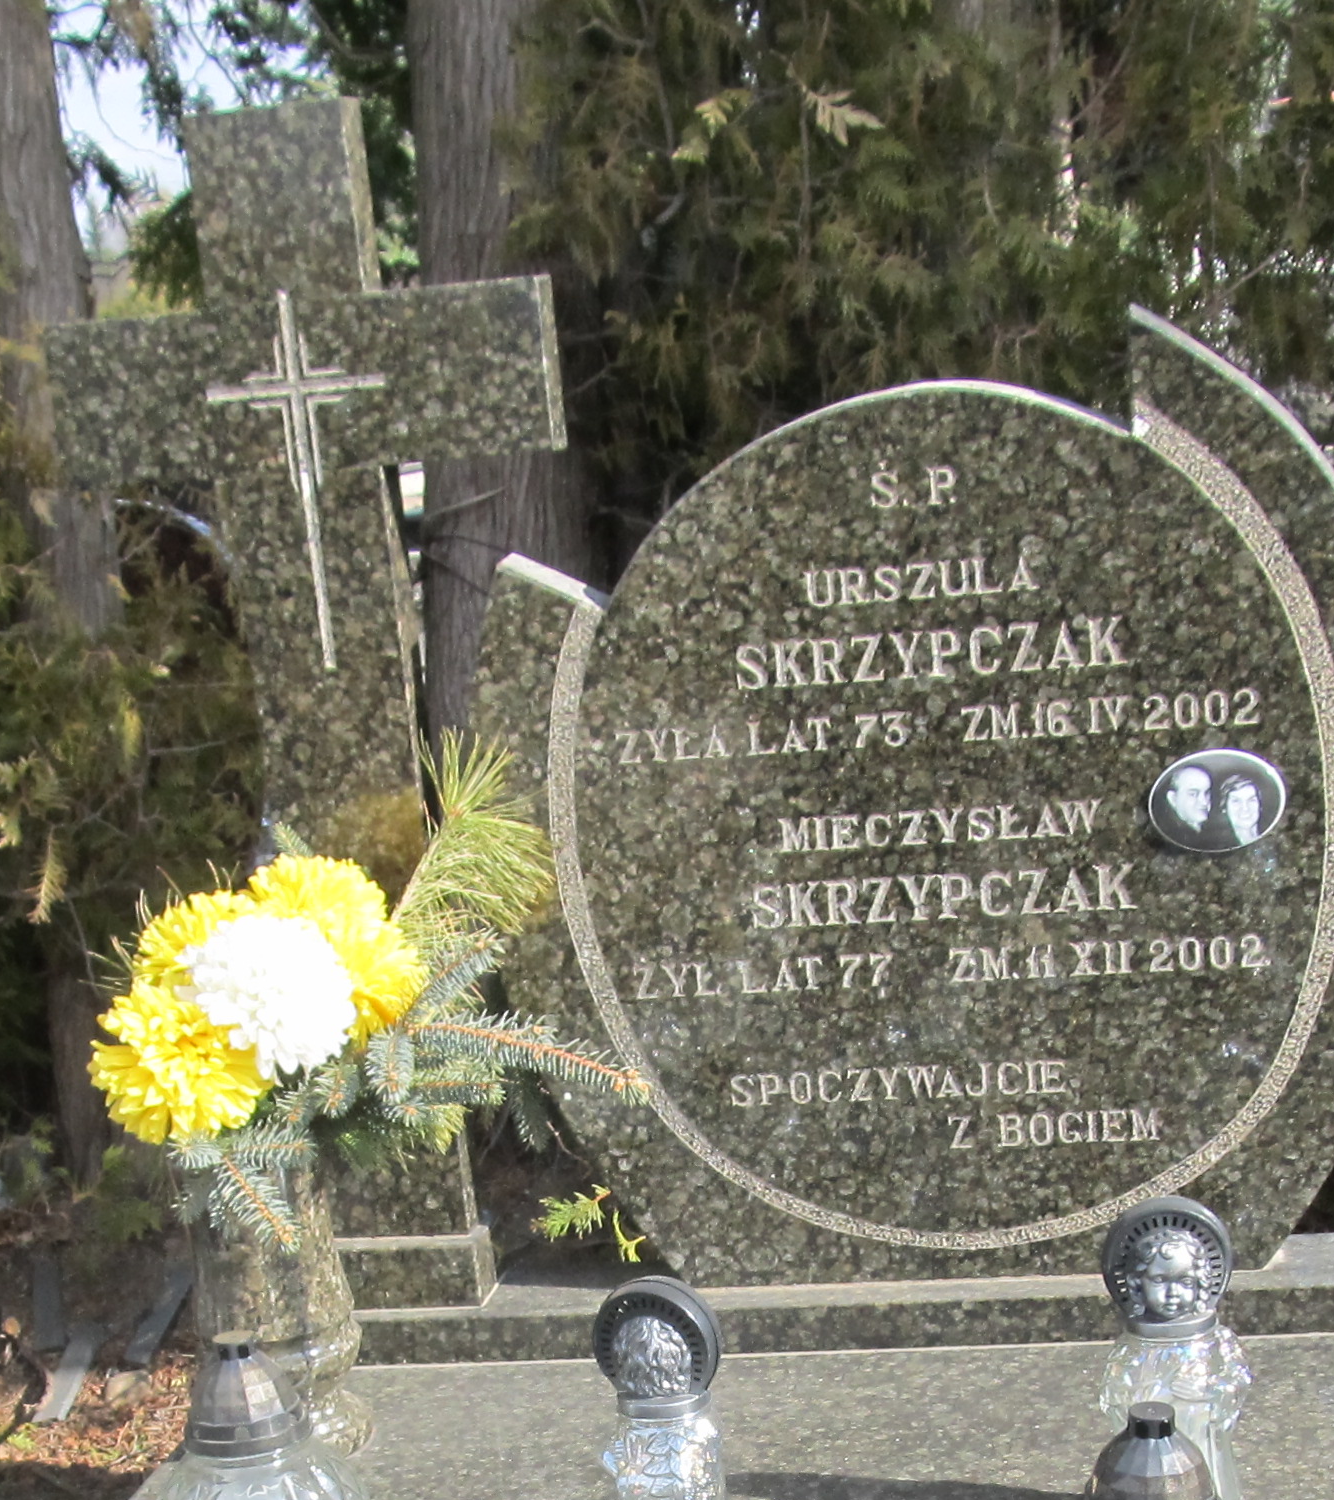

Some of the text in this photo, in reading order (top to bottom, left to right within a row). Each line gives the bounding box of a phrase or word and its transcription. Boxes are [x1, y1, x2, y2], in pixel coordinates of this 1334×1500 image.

[803, 554, 1040, 607] URSZULA
[735, 614, 1129, 691] SKRZYPCZAK
[746, 716, 832, 756] LAT
[854, 711, 912, 748] 73
[1143, 687, 1260, 730] 2002
[777, 799, 1101, 852] MIECZYSŁAW
[752, 862, 1138, 928] SKRZYPCZAK
[739, 957, 824, 993] LAT
[839, 953, 893, 989] 77
[1069, 939, 1134, 977] XII
[1148, 934, 1270, 972] 2002
[729, 1060, 1068, 1107] SPOCZYWAJCIE
[946, 1108, 1161, 1150] Z BOGIEM
